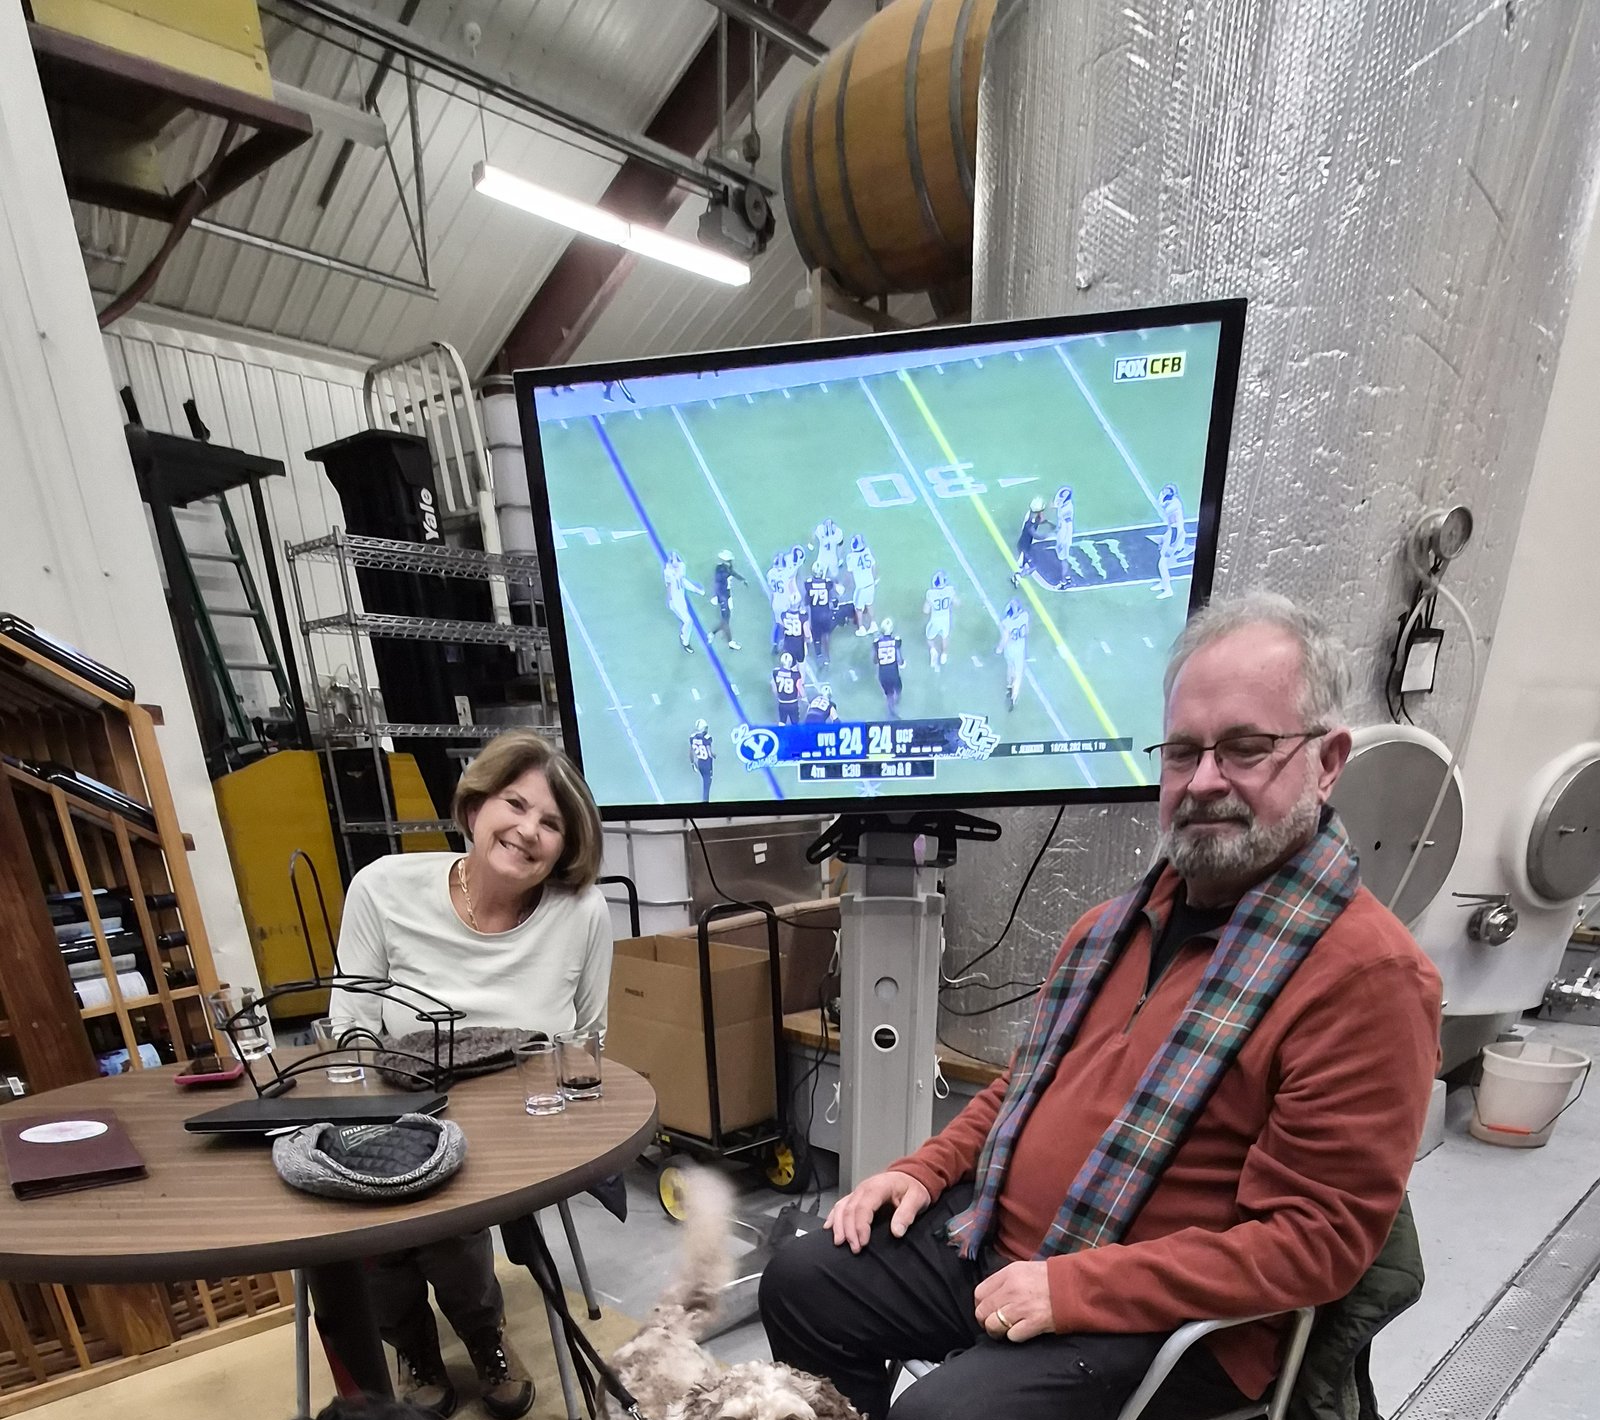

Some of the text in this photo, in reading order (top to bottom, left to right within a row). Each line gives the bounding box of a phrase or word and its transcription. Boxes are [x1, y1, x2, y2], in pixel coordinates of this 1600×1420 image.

[1116, 357, 1182, 379] FOX CFB
[419, 488, 439, 540] Yale
[857, 554, 873, 570] 45
[809, 590, 829, 606] 79
[933, 597, 950, 611] 30
[776, 677, 794, 694] 78
[839, 725, 893, 755] 24 24
[895, 728, 914, 743] UCF
[960, 715, 999, 752] UCF
[743, 735, 769, 759] Y
